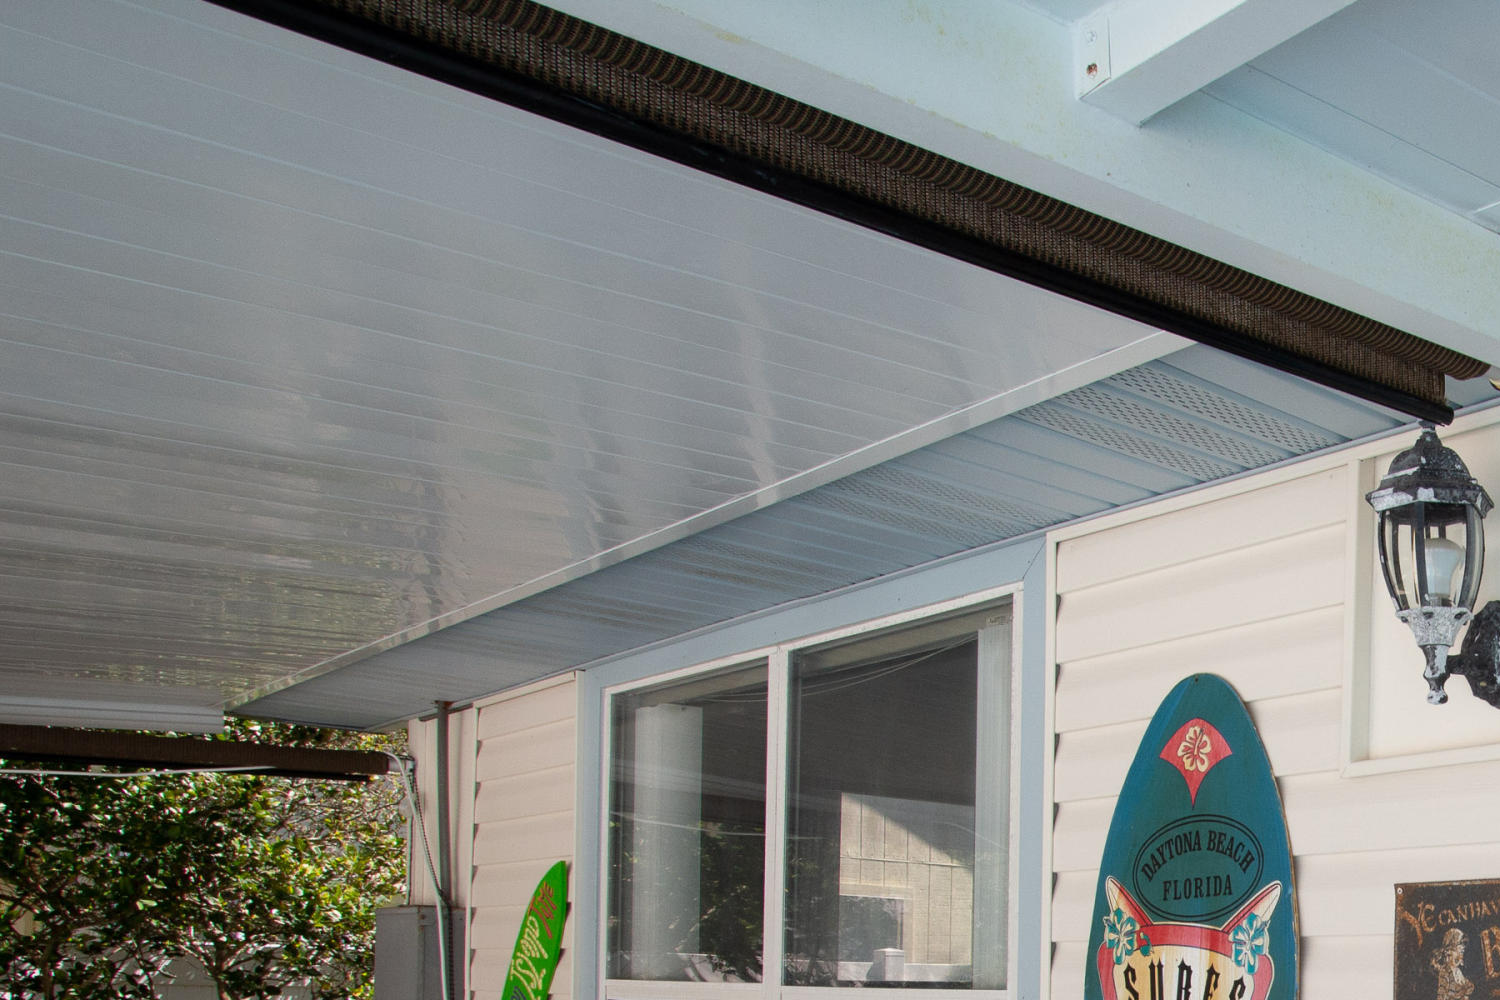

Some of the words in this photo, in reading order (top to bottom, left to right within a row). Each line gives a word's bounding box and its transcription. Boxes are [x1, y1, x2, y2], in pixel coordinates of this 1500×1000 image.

[1141, 830, 1202, 882] DAYTONA
[1206, 830, 1255, 874] BEACH
[1162, 874, 1233, 901] FLORIDA
